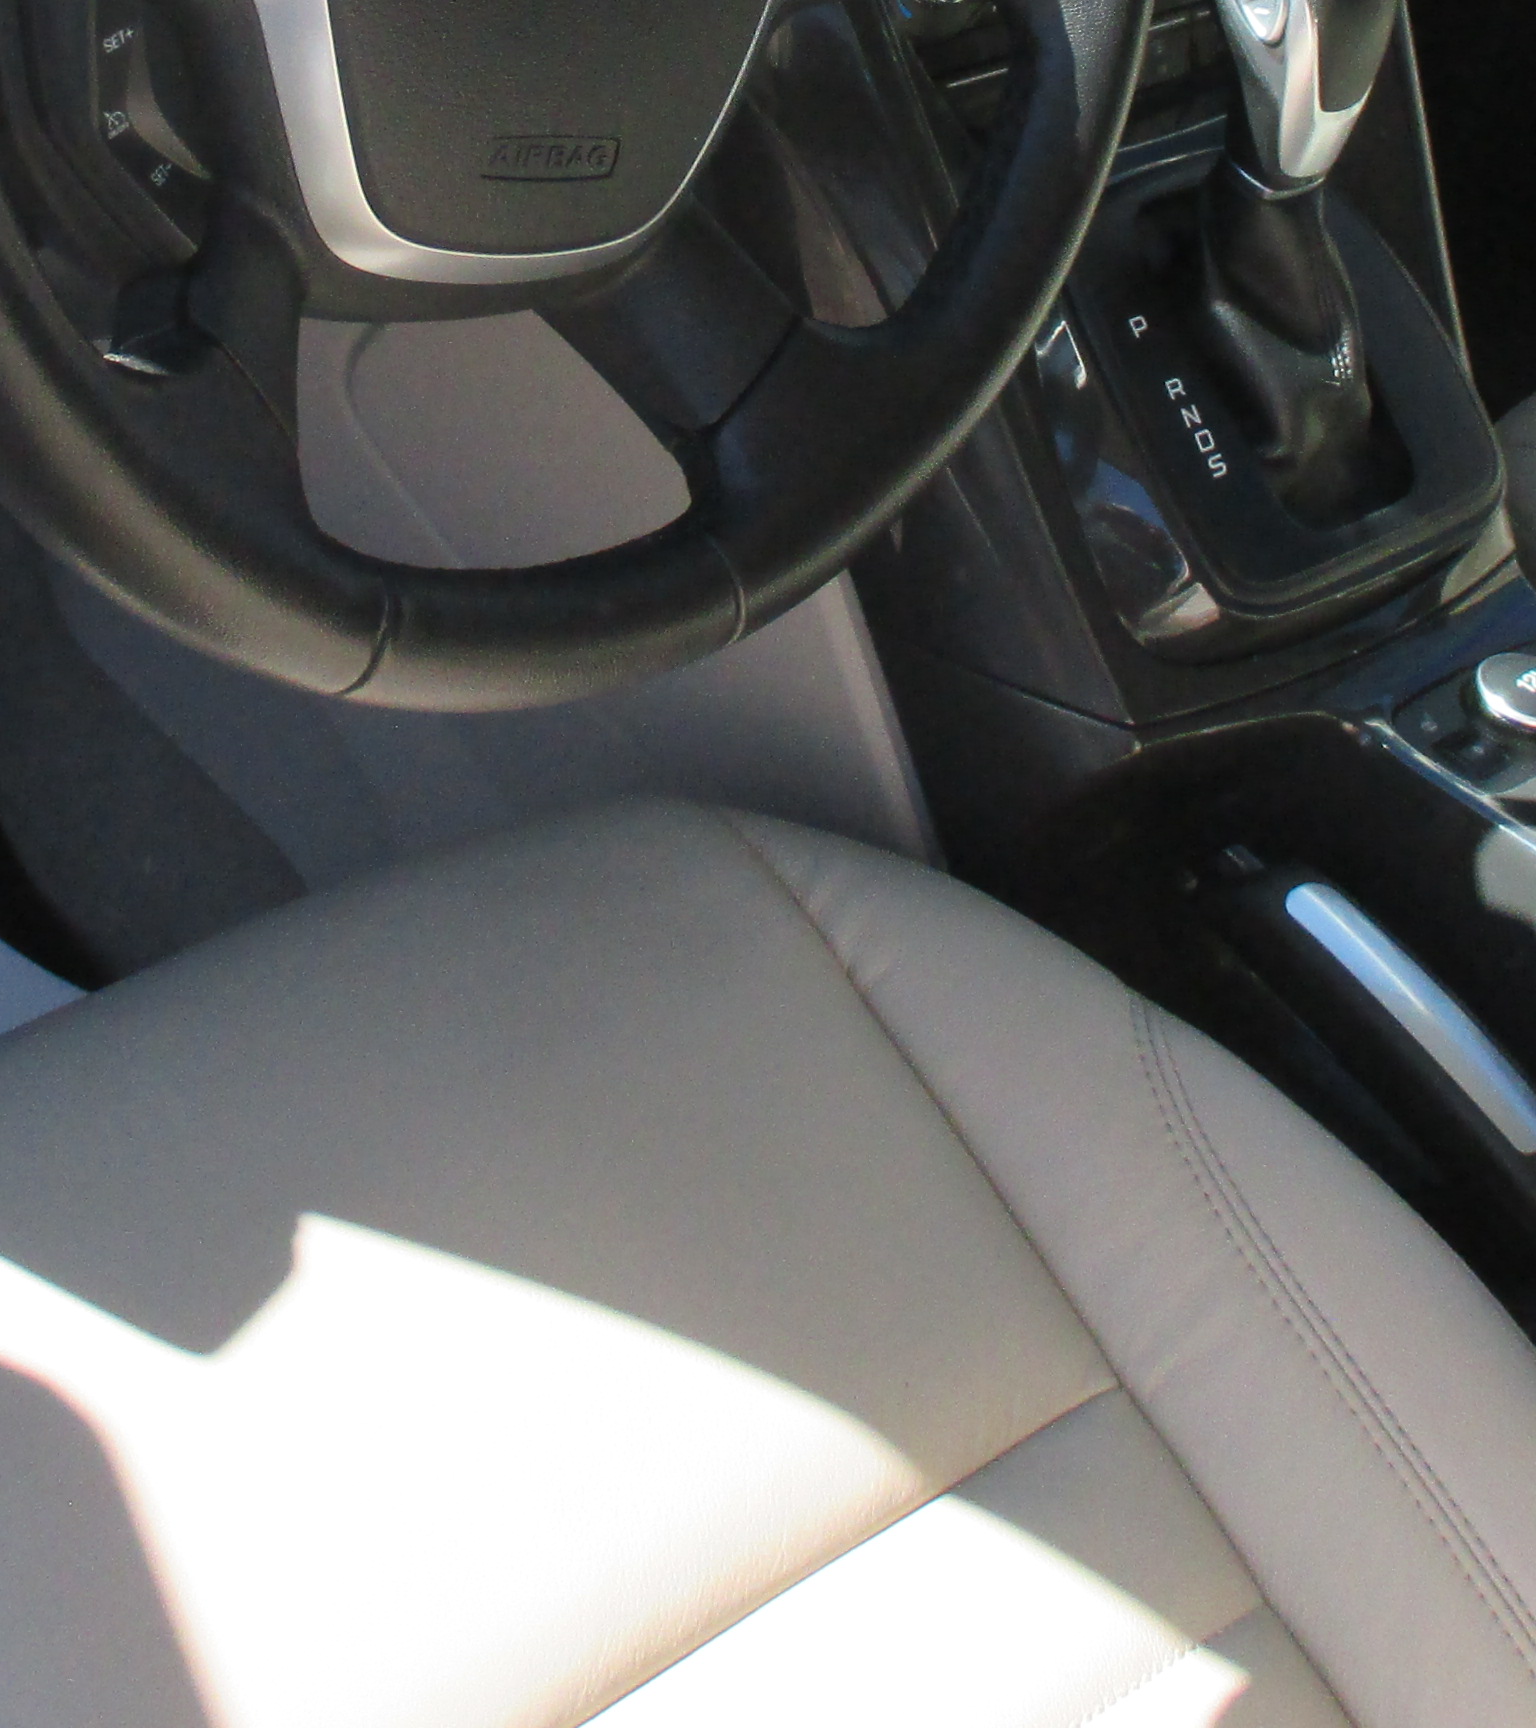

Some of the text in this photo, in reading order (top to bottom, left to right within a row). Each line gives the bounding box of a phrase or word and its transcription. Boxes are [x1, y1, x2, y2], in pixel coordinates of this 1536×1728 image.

[102, 27, 134, 54] SET+
[488, 144, 608, 169] AIRBAG
[1129, 315, 1228, 478] P R N D S
